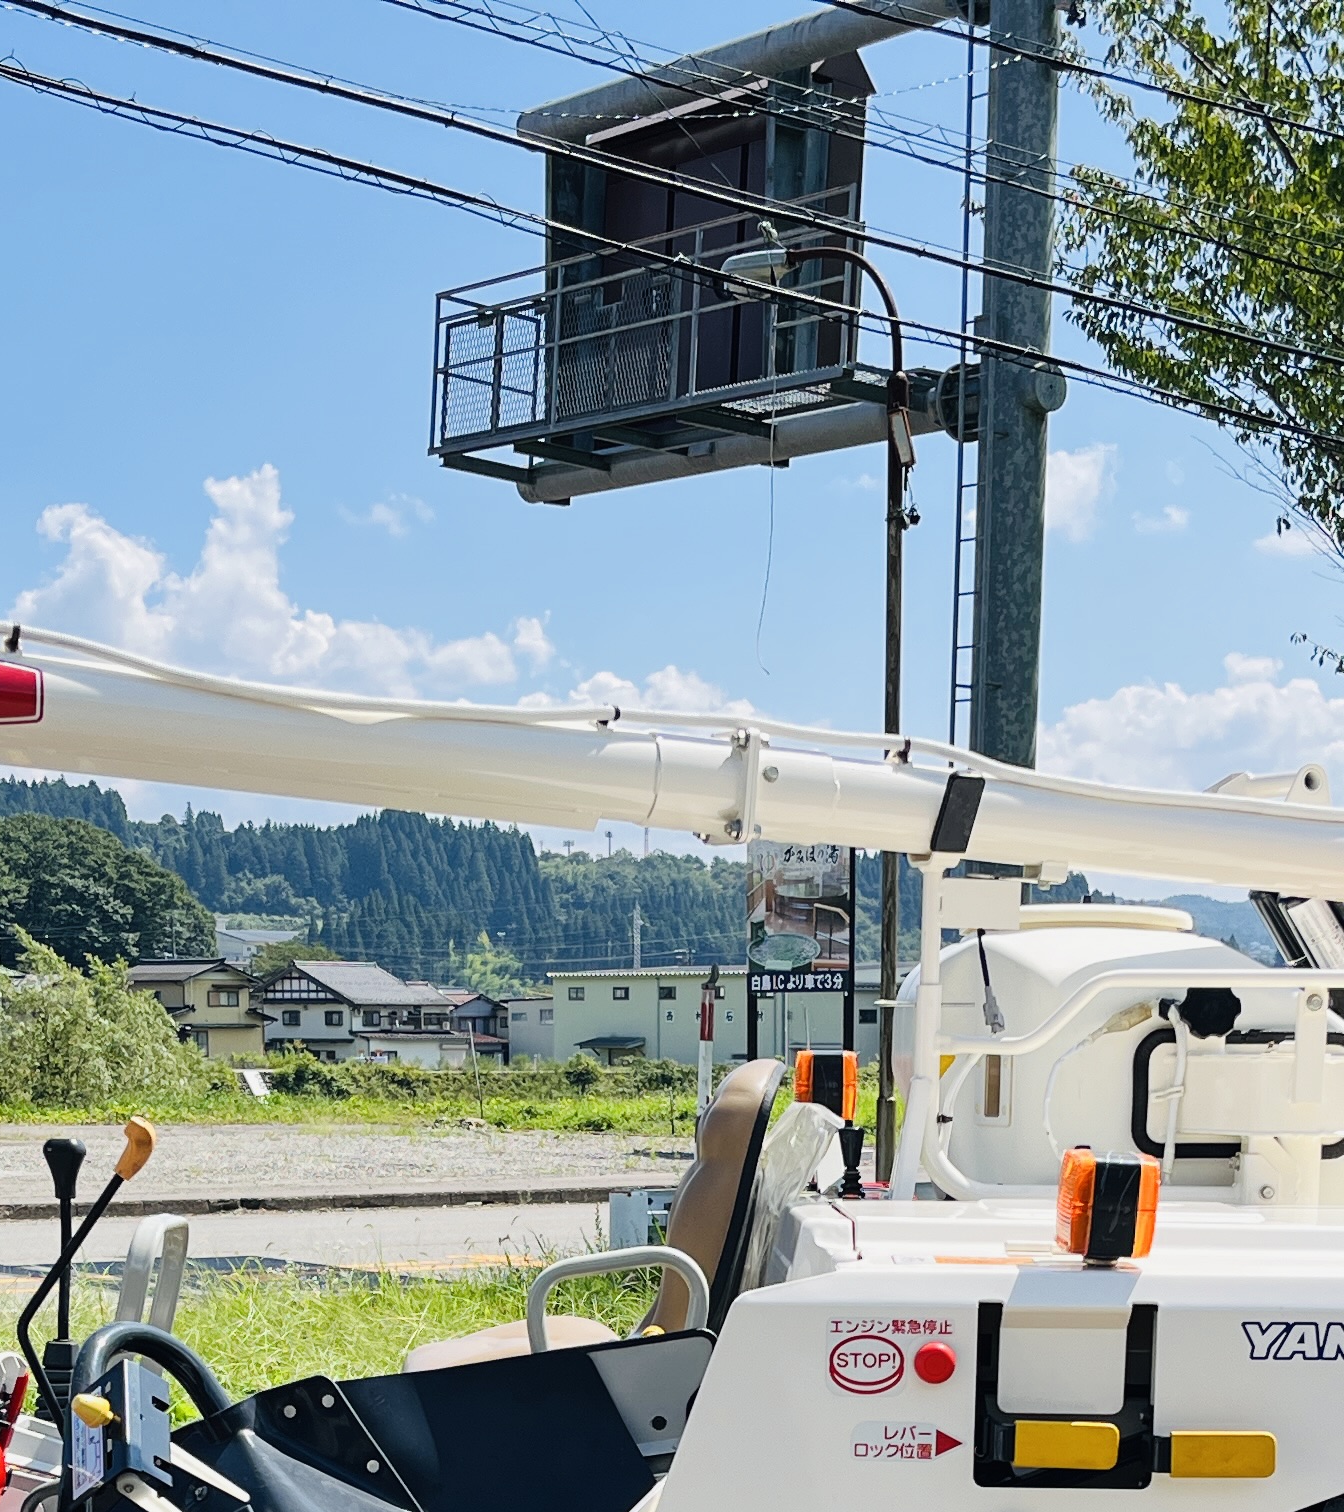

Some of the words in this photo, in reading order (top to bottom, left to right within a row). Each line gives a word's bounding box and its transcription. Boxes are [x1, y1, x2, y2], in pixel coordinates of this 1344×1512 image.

[830, 1319, 953, 1335] エンジン緊急停止
[836, 1352, 897, 1370] STOP!
[884, 1425, 932, 1441] レバー
[854, 1443, 933, 1460] ロック位置
